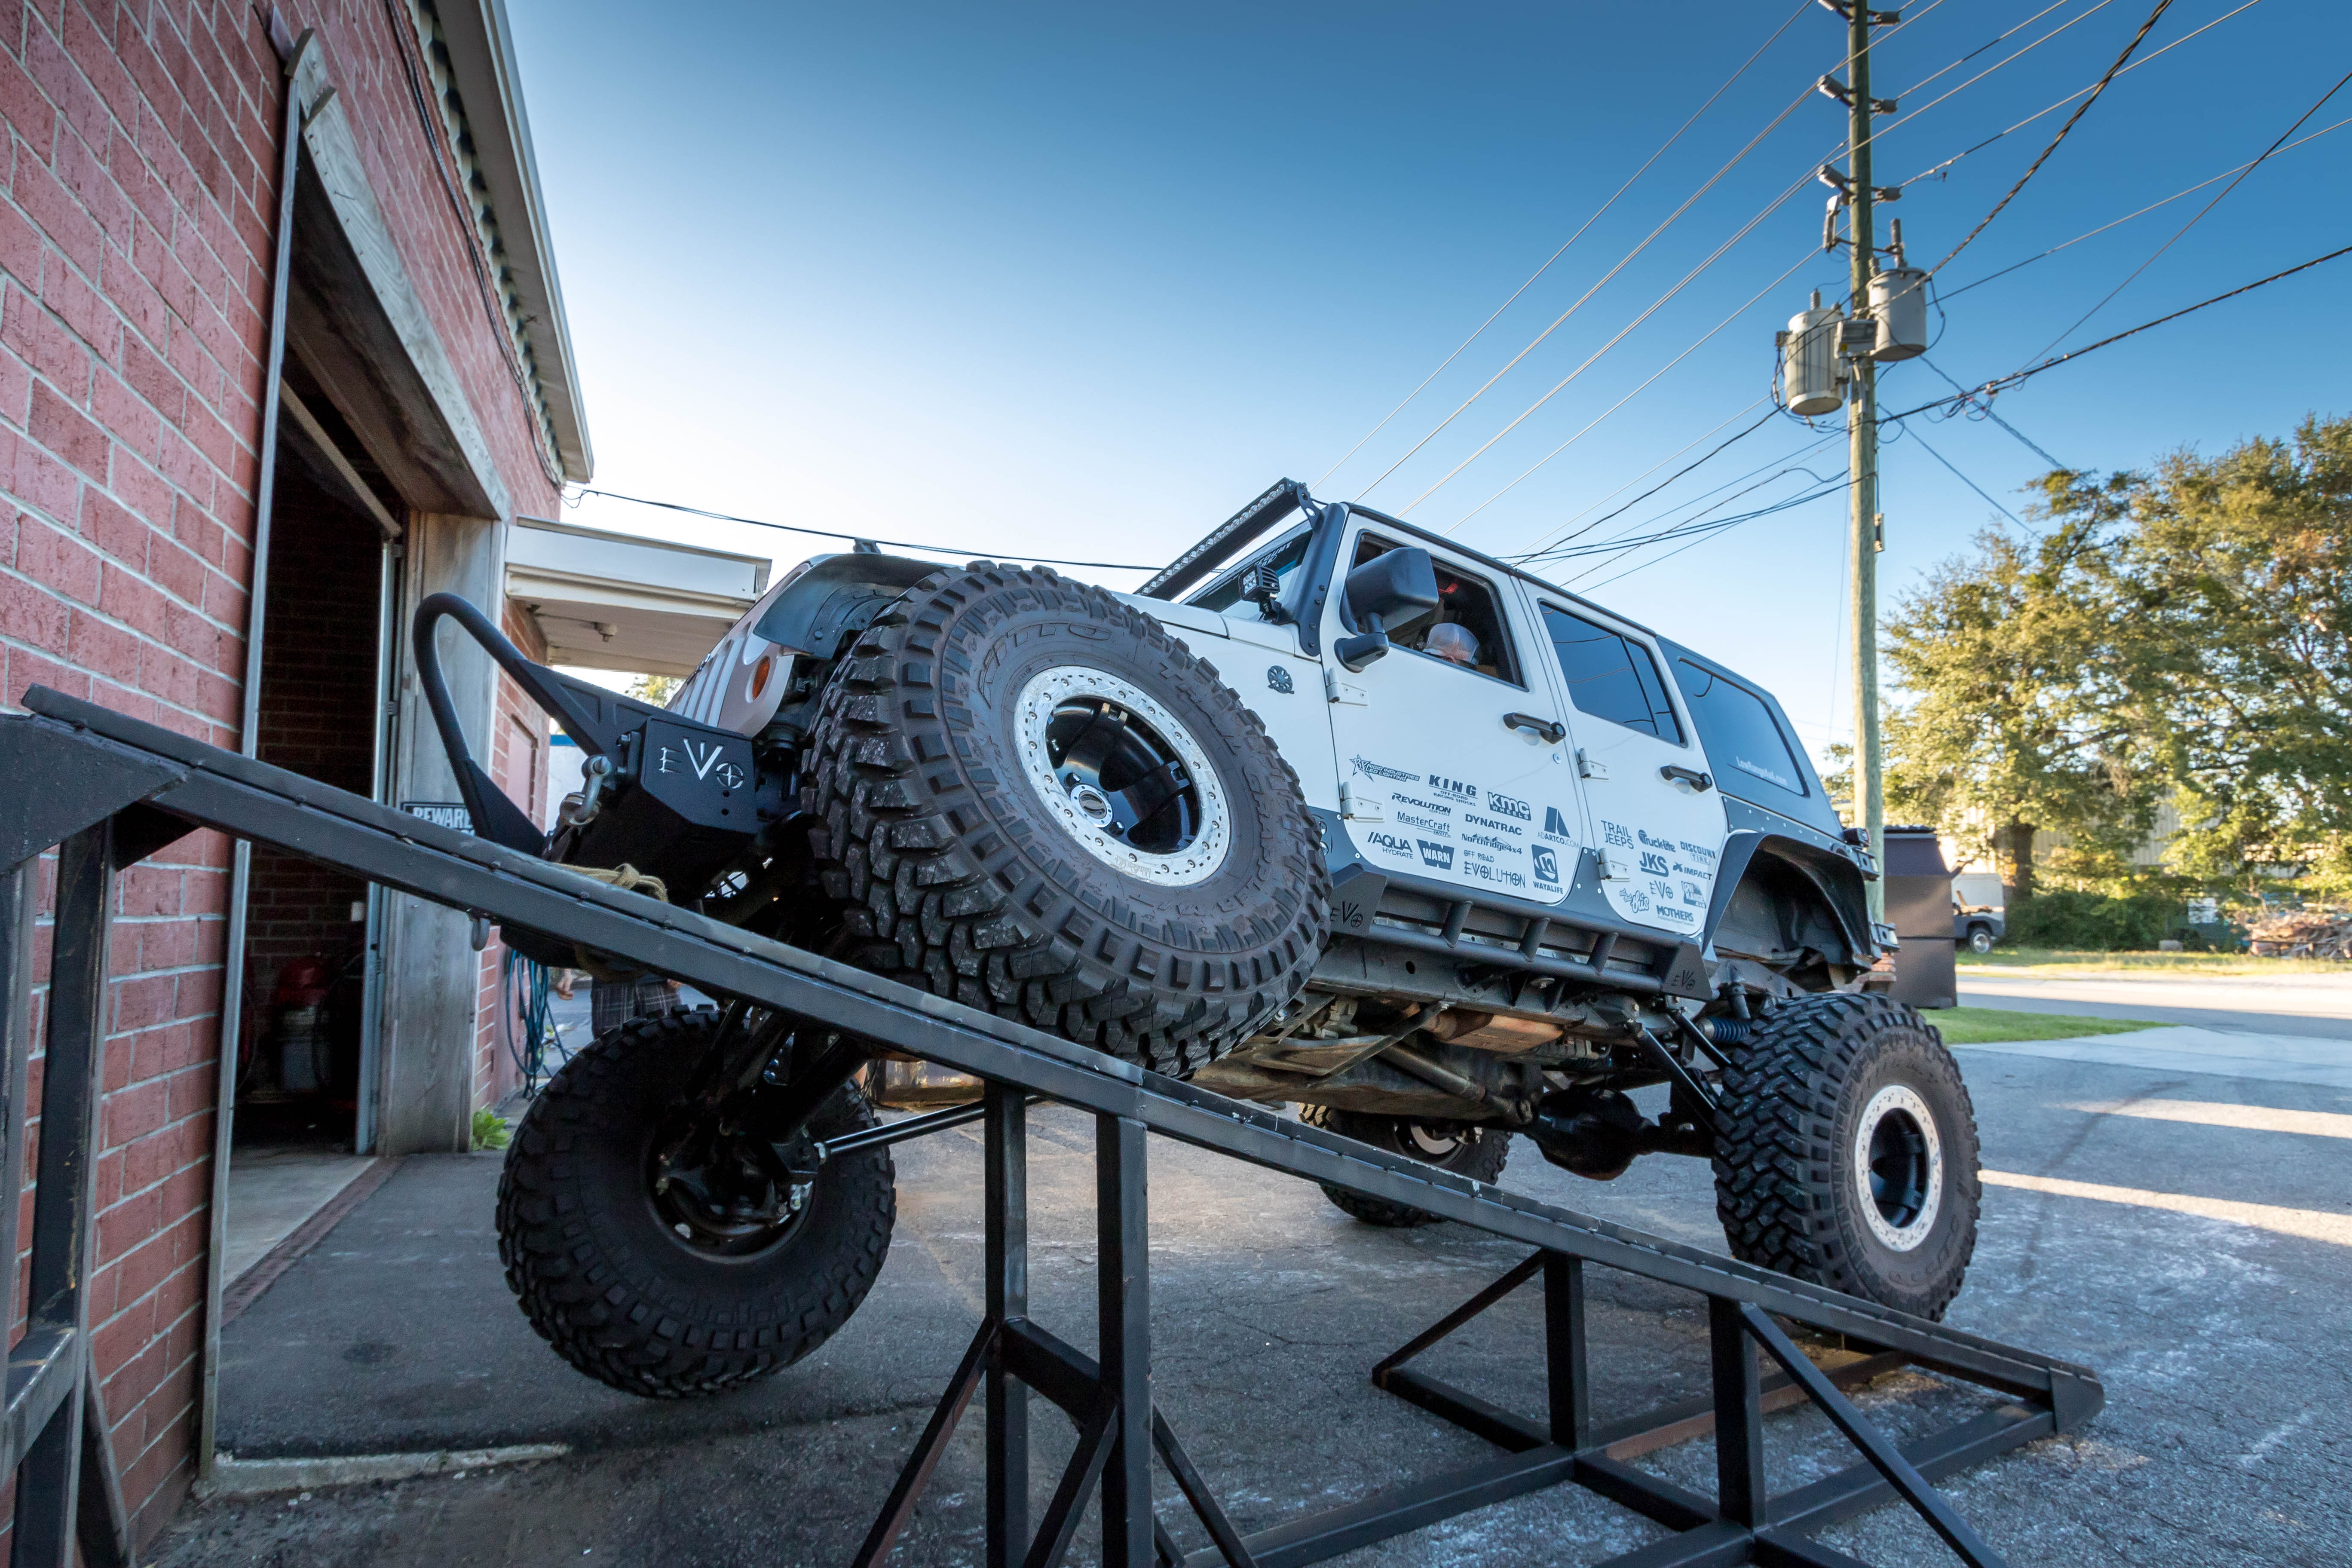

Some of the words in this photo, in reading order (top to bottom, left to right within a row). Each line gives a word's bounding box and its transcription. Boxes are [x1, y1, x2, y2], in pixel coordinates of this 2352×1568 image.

[658, 738, 744, 789] EVO
[1367, 763, 1383, 771] RIGID
[1383, 768, 1420, 781] INDUSTRIES
[1378, 771, 1407, 781] LIGHTING
[1429, 774, 1477, 796] KING
[1391, 792, 1451, 814] REVOLUTION
[1433, 792, 1454, 801] RACING
[1456, 798, 1476, 807] SHOCKS
[1491, 805, 1529, 819] WHEELS
[1397, 811, 1450, 832] MasterCraft
[1465, 814, 1522, 836] DYNATRAC
[1601, 820, 1632, 838] TRAIL
[1461, 833, 1522, 854] Northridge4x4
[1537, 831, 1580, 849] ADARTCO.COM
[1605, 833, 1634, 849] JEEPS
[1382, 847, 1414, 860] HYDRATE
[1422, 847, 1451, 864] WARN
[1680, 841, 1716, 859] DISCOUNT
[1692, 854, 1709, 864] TIRE
[1639, 851, 1669, 877] JKS
[1464, 861, 1526, 889] EVOLUTION
[1684, 867, 1712, 880] IMPACT
[1533, 881, 1564, 895] WAYALIFE
[1649, 880, 1674, 899] EVO
[1656, 905, 1694, 922] MOTHERS
